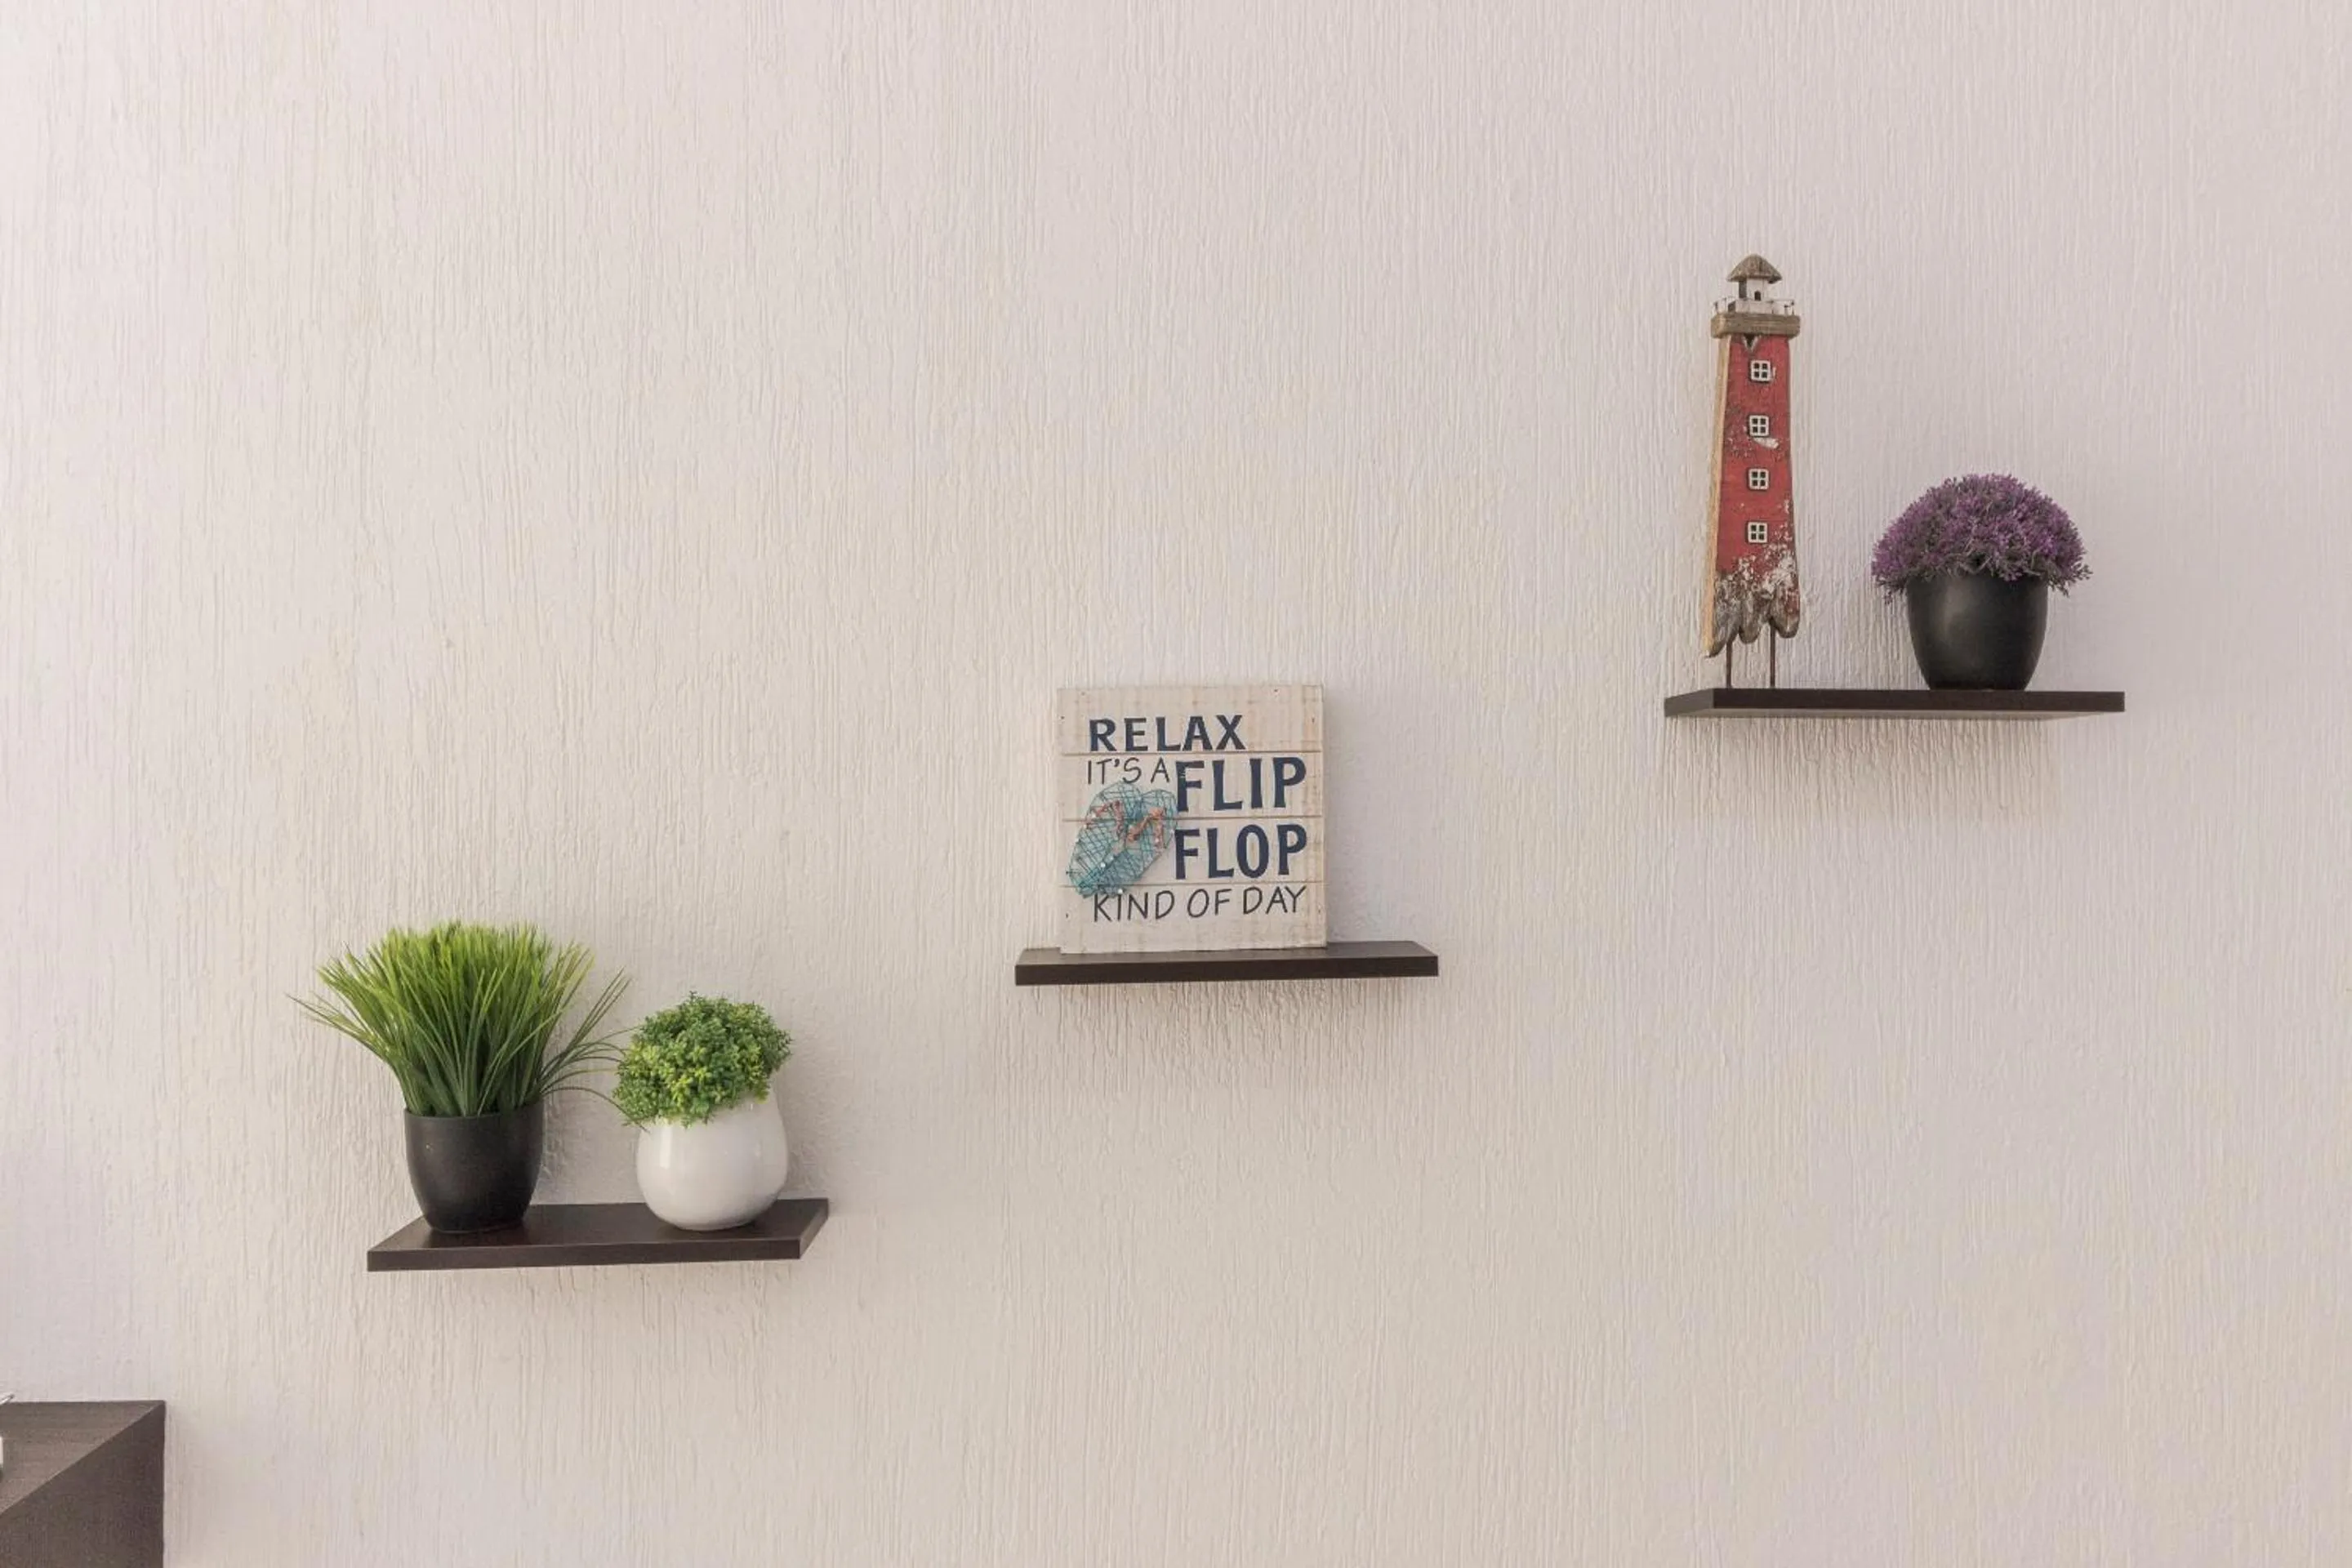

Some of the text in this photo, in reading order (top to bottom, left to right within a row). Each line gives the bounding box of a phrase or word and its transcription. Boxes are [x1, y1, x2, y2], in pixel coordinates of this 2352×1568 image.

[1089, 715, 1246, 752] RELAX
[1087, 756, 1307, 813] IT'S A FLIP
[1174, 823, 1307, 880] FLOP
[1093, 885, 1307, 923] KIND OF DAY
